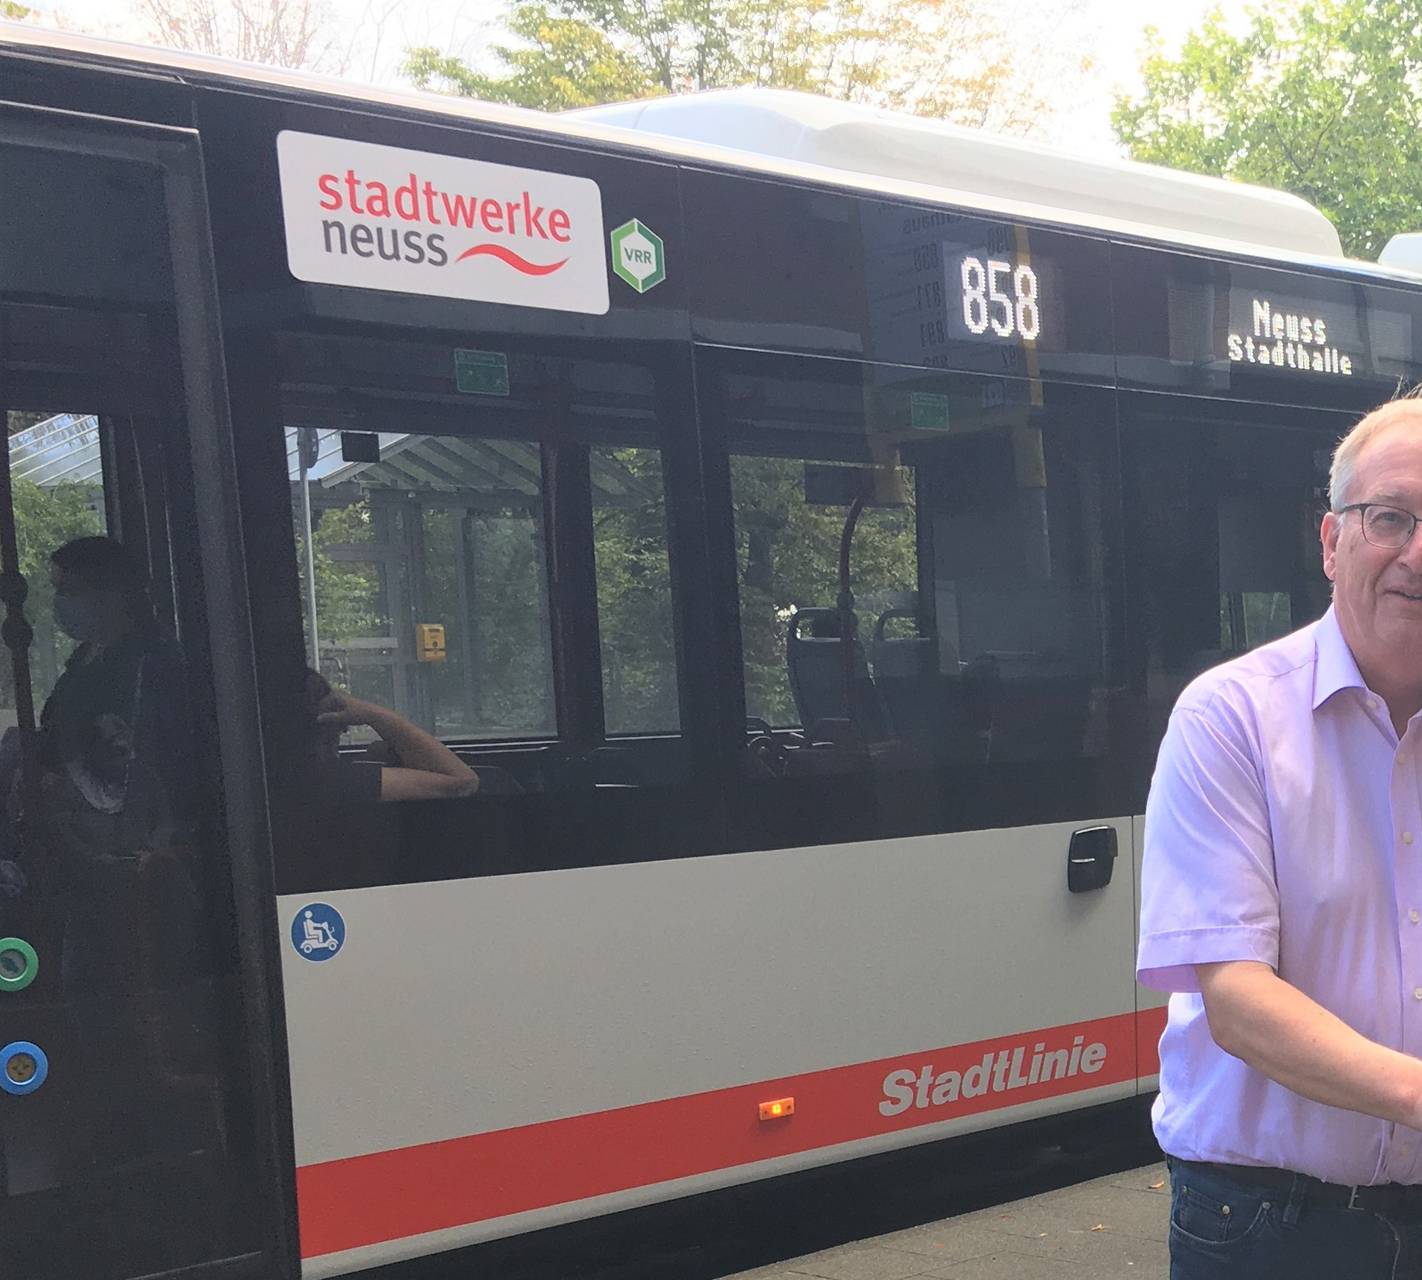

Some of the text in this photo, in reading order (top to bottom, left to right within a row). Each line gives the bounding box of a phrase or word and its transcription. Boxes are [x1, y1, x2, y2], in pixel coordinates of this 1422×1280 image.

[318, 169, 572, 243] stadtwerke
[322, 218, 448, 267] neuss
[624, 247, 652, 265] VRR
[961, 256, 1040, 340] 858
[1252, 298, 1327, 345] Neuss
[1227, 333, 1353, 375] Stadthalle
[879, 1035, 1107, 1117] StadtLinie
